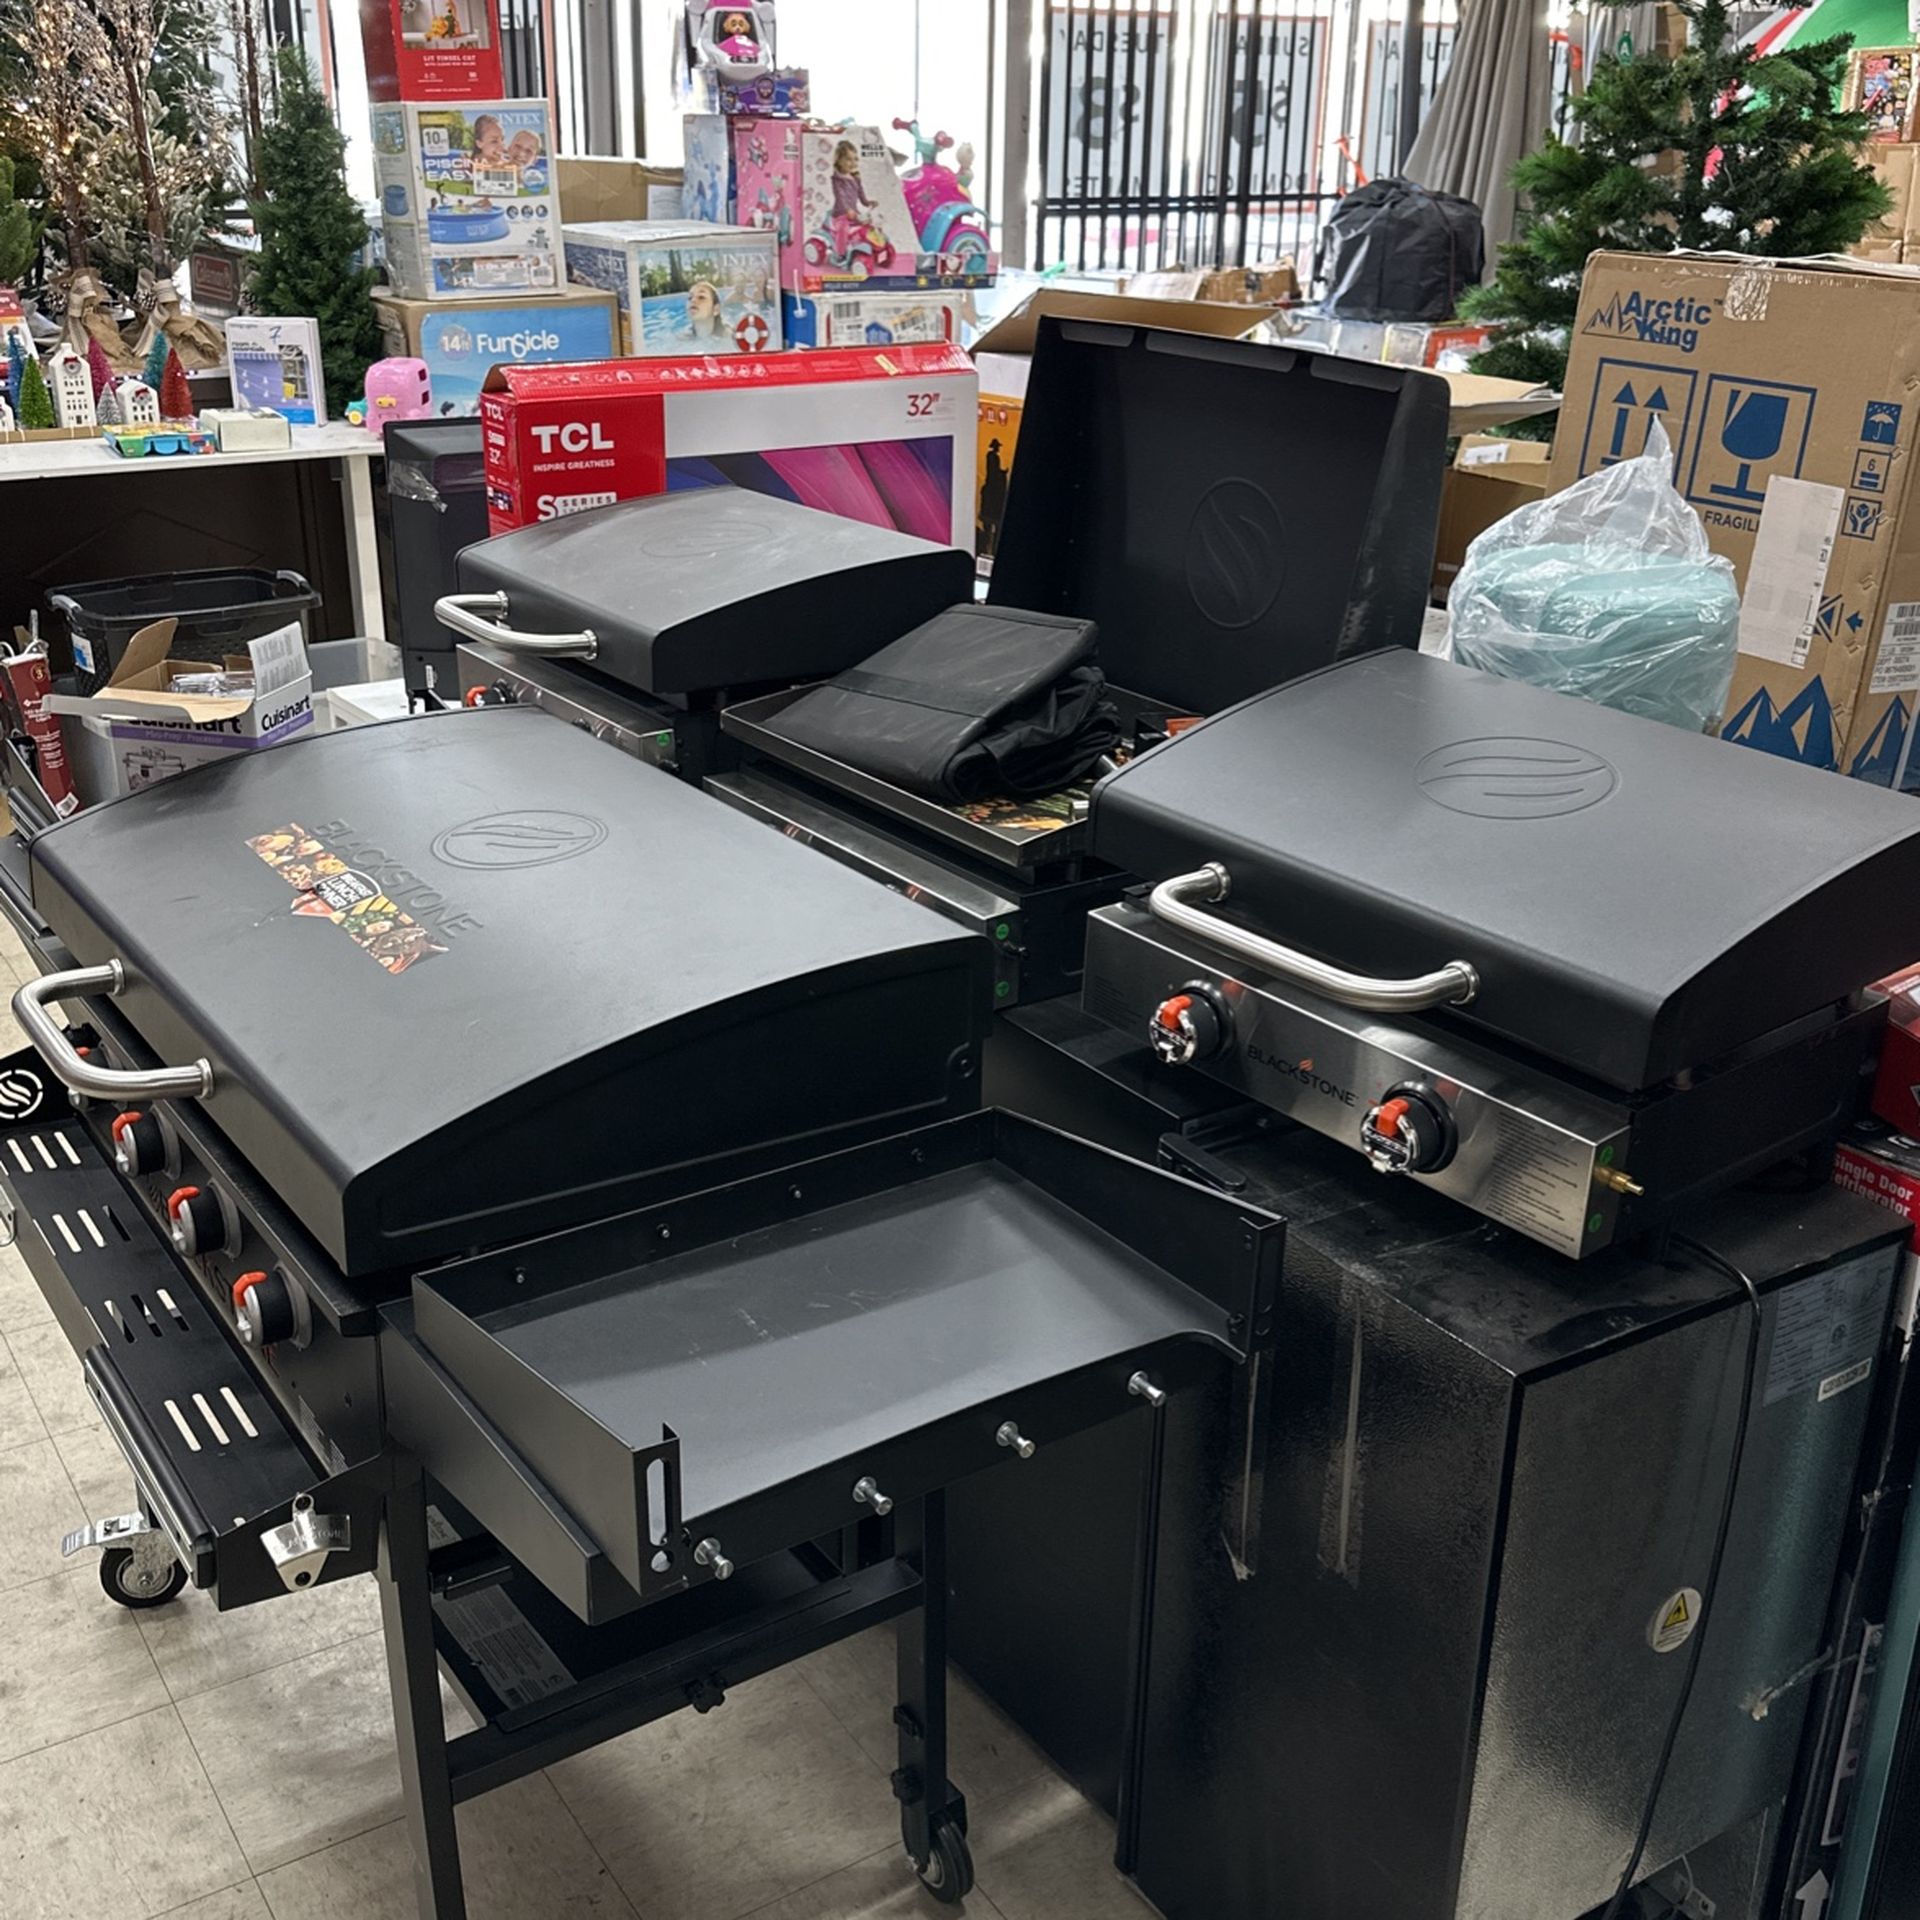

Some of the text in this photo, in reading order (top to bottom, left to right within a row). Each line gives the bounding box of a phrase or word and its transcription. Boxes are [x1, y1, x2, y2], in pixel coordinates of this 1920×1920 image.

[499, 112, 541, 124] INTEX
[723, 253, 769, 267] INTEX
[1623, 291, 1711, 325] Arctic
[1635, 318, 1698, 353] King
[531, 422, 615, 454] TCL
[533, 459, 615, 473] INSPIRE GREATNESS
[1867, 460, 1876, 472] 6
[562, 495, 613, 507] SERIES
[261, 695, 311, 732] Cuisinart
[309, 818, 484, 939] BLACKSTONE
[1247, 1044, 1355, 1108] BLACKSTONE
[1879, 1174, 1915, 1201] Door
